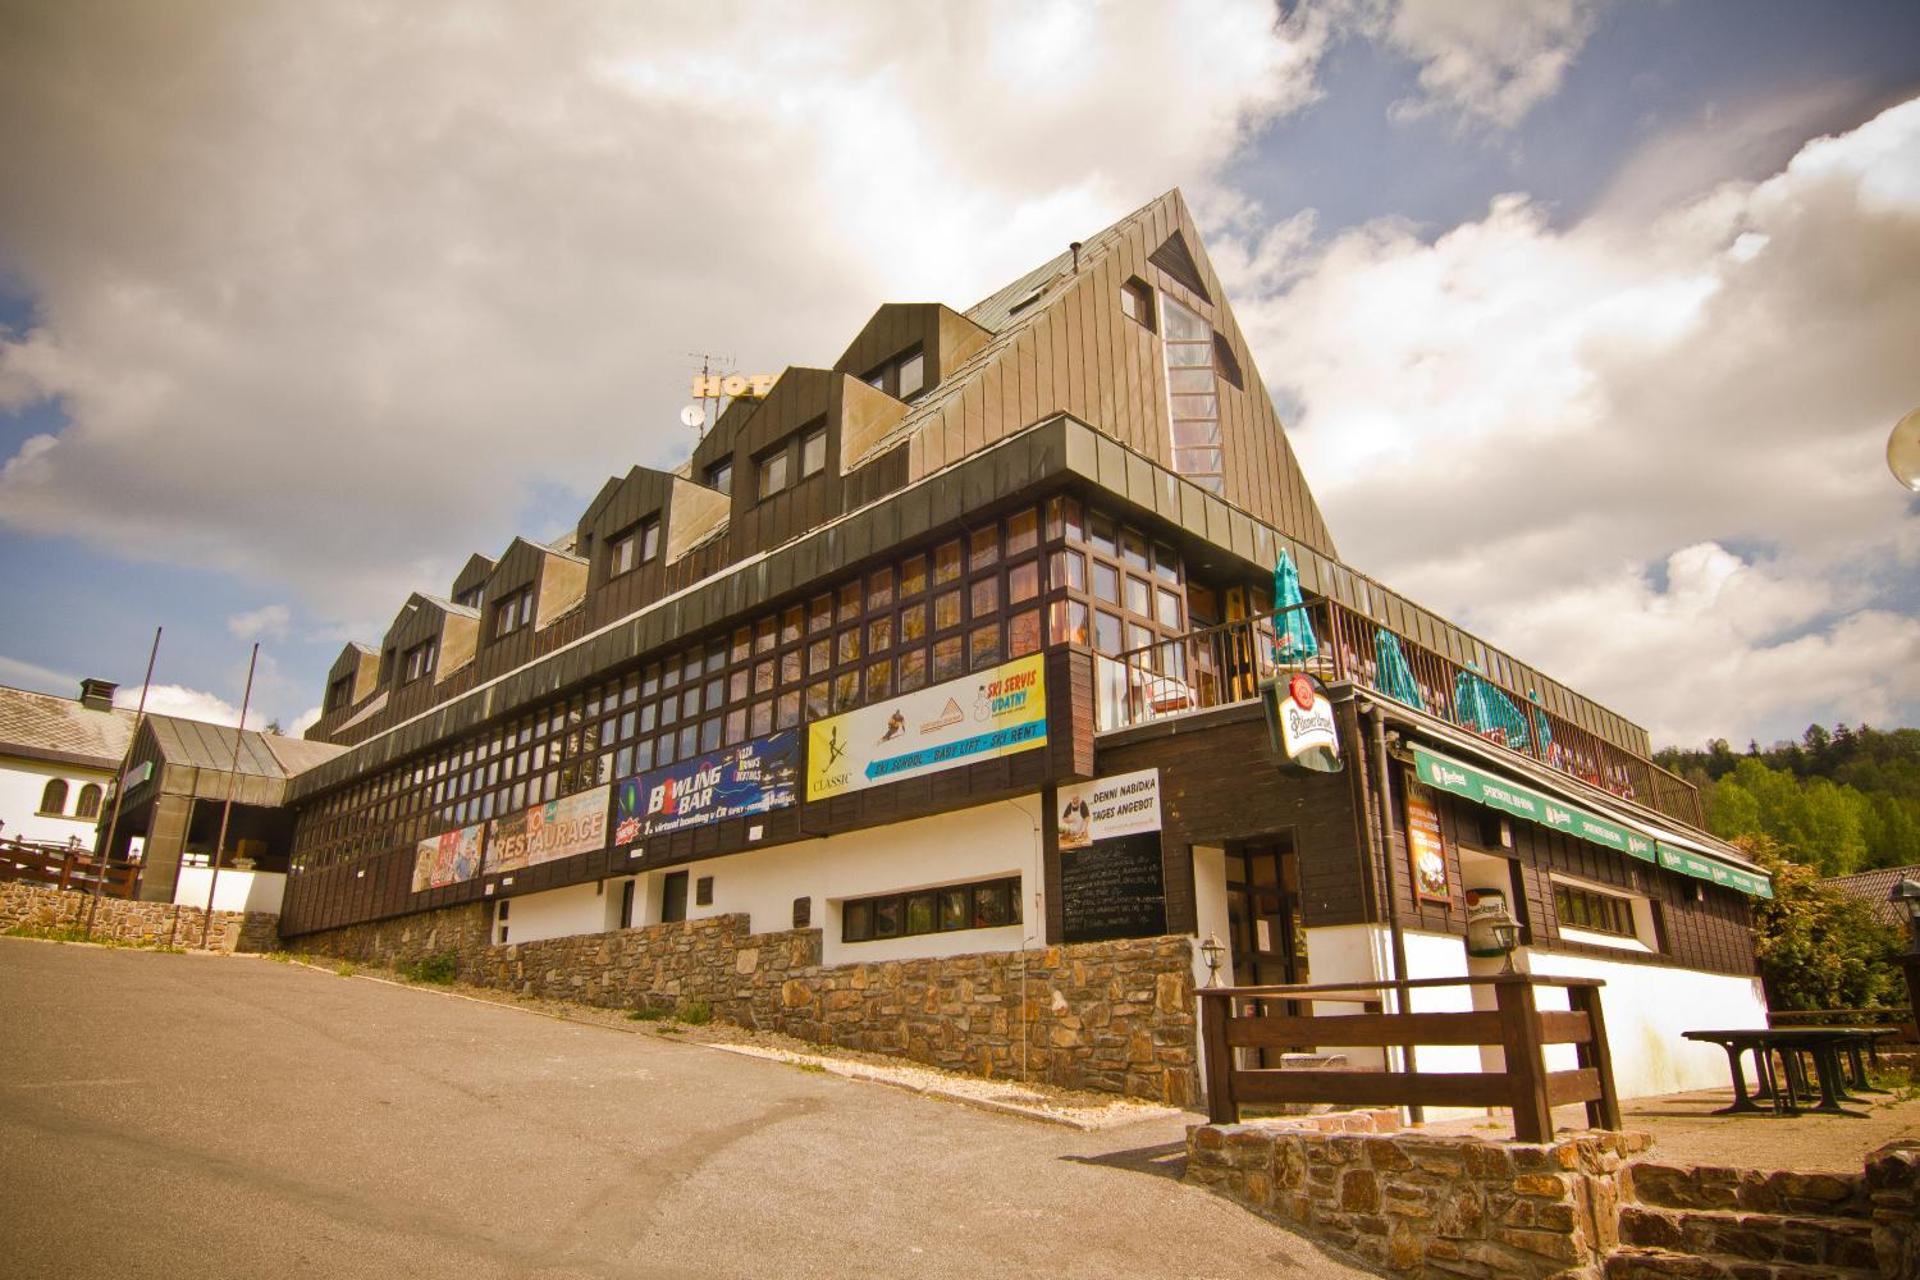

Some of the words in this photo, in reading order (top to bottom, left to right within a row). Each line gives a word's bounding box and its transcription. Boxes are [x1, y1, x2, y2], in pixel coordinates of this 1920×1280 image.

[692, 375, 780, 399] HOT
[988, 681, 1001, 698] SKI
[1005, 670, 1036, 692] SERVIS
[1011, 724, 1038, 743] RENT
[678, 787, 712, 815] BAR
[1092, 807, 1115, 822] TAGES
[1117, 796, 1154, 816] ANGEBOT
